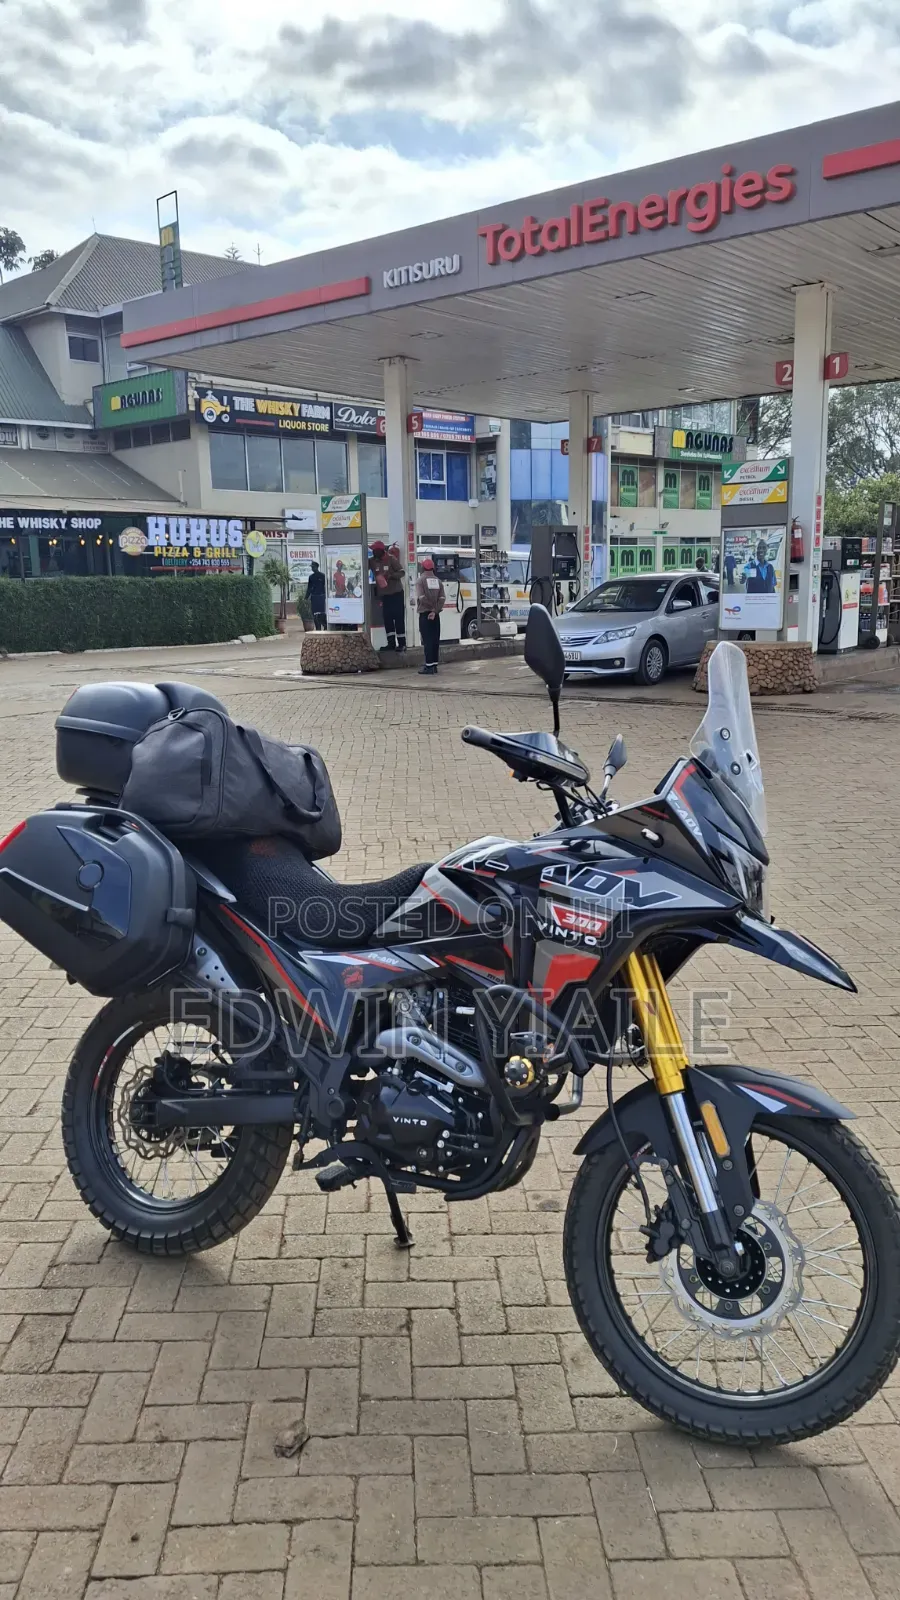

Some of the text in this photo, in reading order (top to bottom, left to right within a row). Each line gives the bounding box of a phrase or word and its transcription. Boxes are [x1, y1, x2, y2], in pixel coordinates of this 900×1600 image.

[478, 162, 796, 266] TotalEnergies
[781, 363, 793, 382] 2
[832, 356, 841, 375] 1
[233, 396, 330, 420] THE WHISKY FARM
[335, 406, 377, 426] Dolce
[279, 419, 306, 431] LIQUOR
[308, 422, 329, 432] STORE
[412, 415, 419, 430] 5
[591, 438, 598, 451] 7
[0, 517, 101, 529] HE WHISKY SHOP
[146, 516, 243, 548] HUHUS
[154, 546, 189, 557] PIZZA
[205, 547, 238, 558] GRILL
[289, 550, 316, 559] CHEMIST
[562, 912, 603, 931] 300
[537, 920, 598, 946] VINTO
[392, 1116, 428, 1126] VINTO
